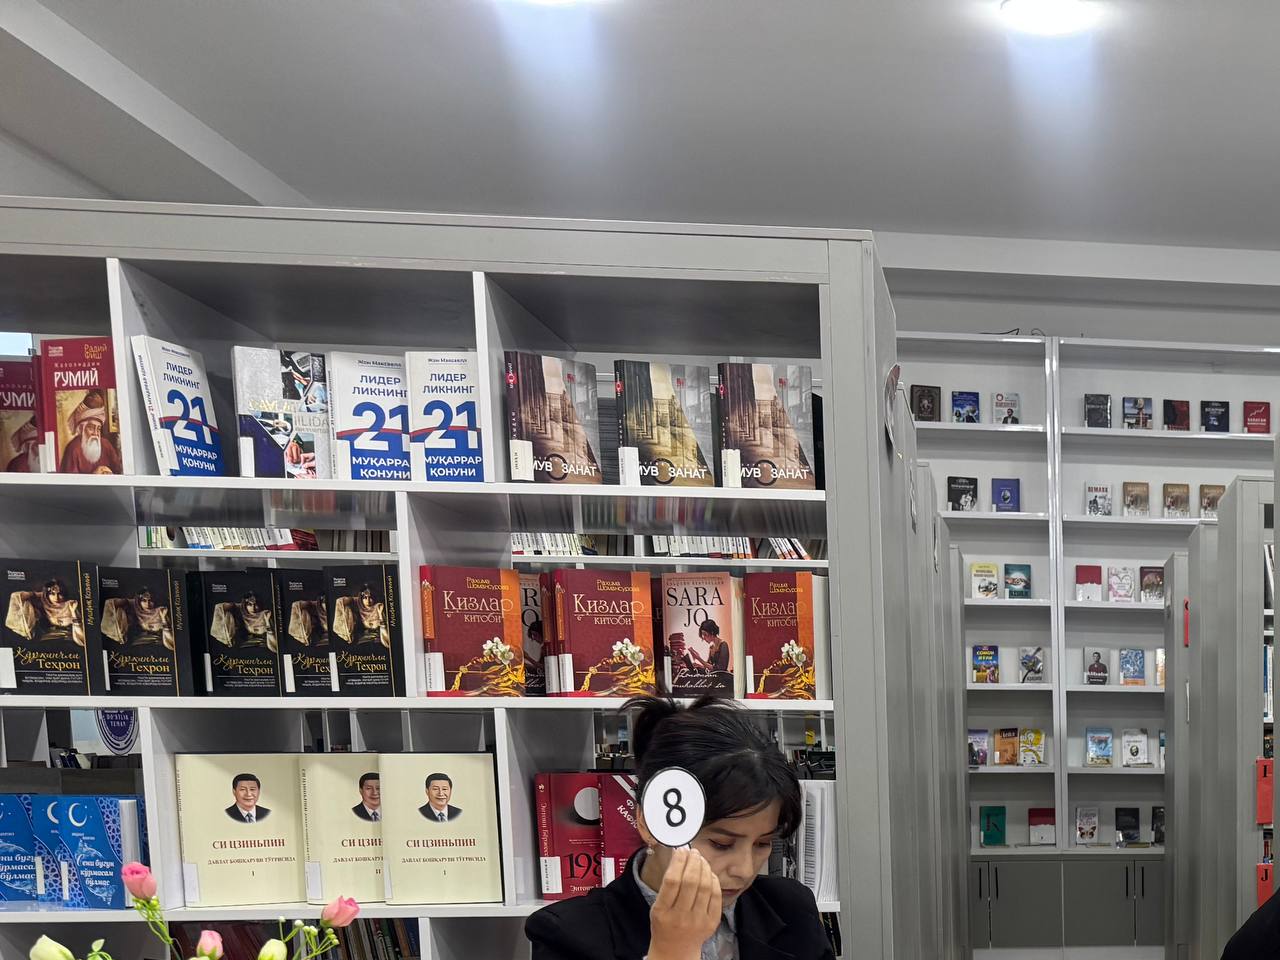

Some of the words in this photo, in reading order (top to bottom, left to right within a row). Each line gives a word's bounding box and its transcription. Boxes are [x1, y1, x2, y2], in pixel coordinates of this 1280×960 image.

[166, 361, 193, 376] ЛИДЕР
[54, 367, 99, 387] РУМИЙ
[163, 373, 201, 390] ЛИКНИНГ
[359, 374, 401, 385] ЛИДЕР
[429, 373, 467, 383] ЛИДЕР
[423, 385, 475, 395] ЛИКНИНГ
[167, 389, 213, 445] 21
[352, 401, 410, 452] 21
[423, 400, 478, 449] 21
[352, 455, 411, 469] МУҚАРРА
[666, 586, 725, 607] SARA
[464, 613, 501, 623] китоби
[594, 616, 631, 626] китоби
[767, 618, 797, 627] китоби
[663, 787, 687, 828] 8
[212, 840, 227, 849] СИ
[229, 838, 285, 850] ЦЗИНЬПИН
[341, 838, 355, 848] СИ
[406, 839, 421, 848] СИ
[422, 838, 476, 848] ЦЗИНЬПИН
[1261, 868, 1269, 882] J
